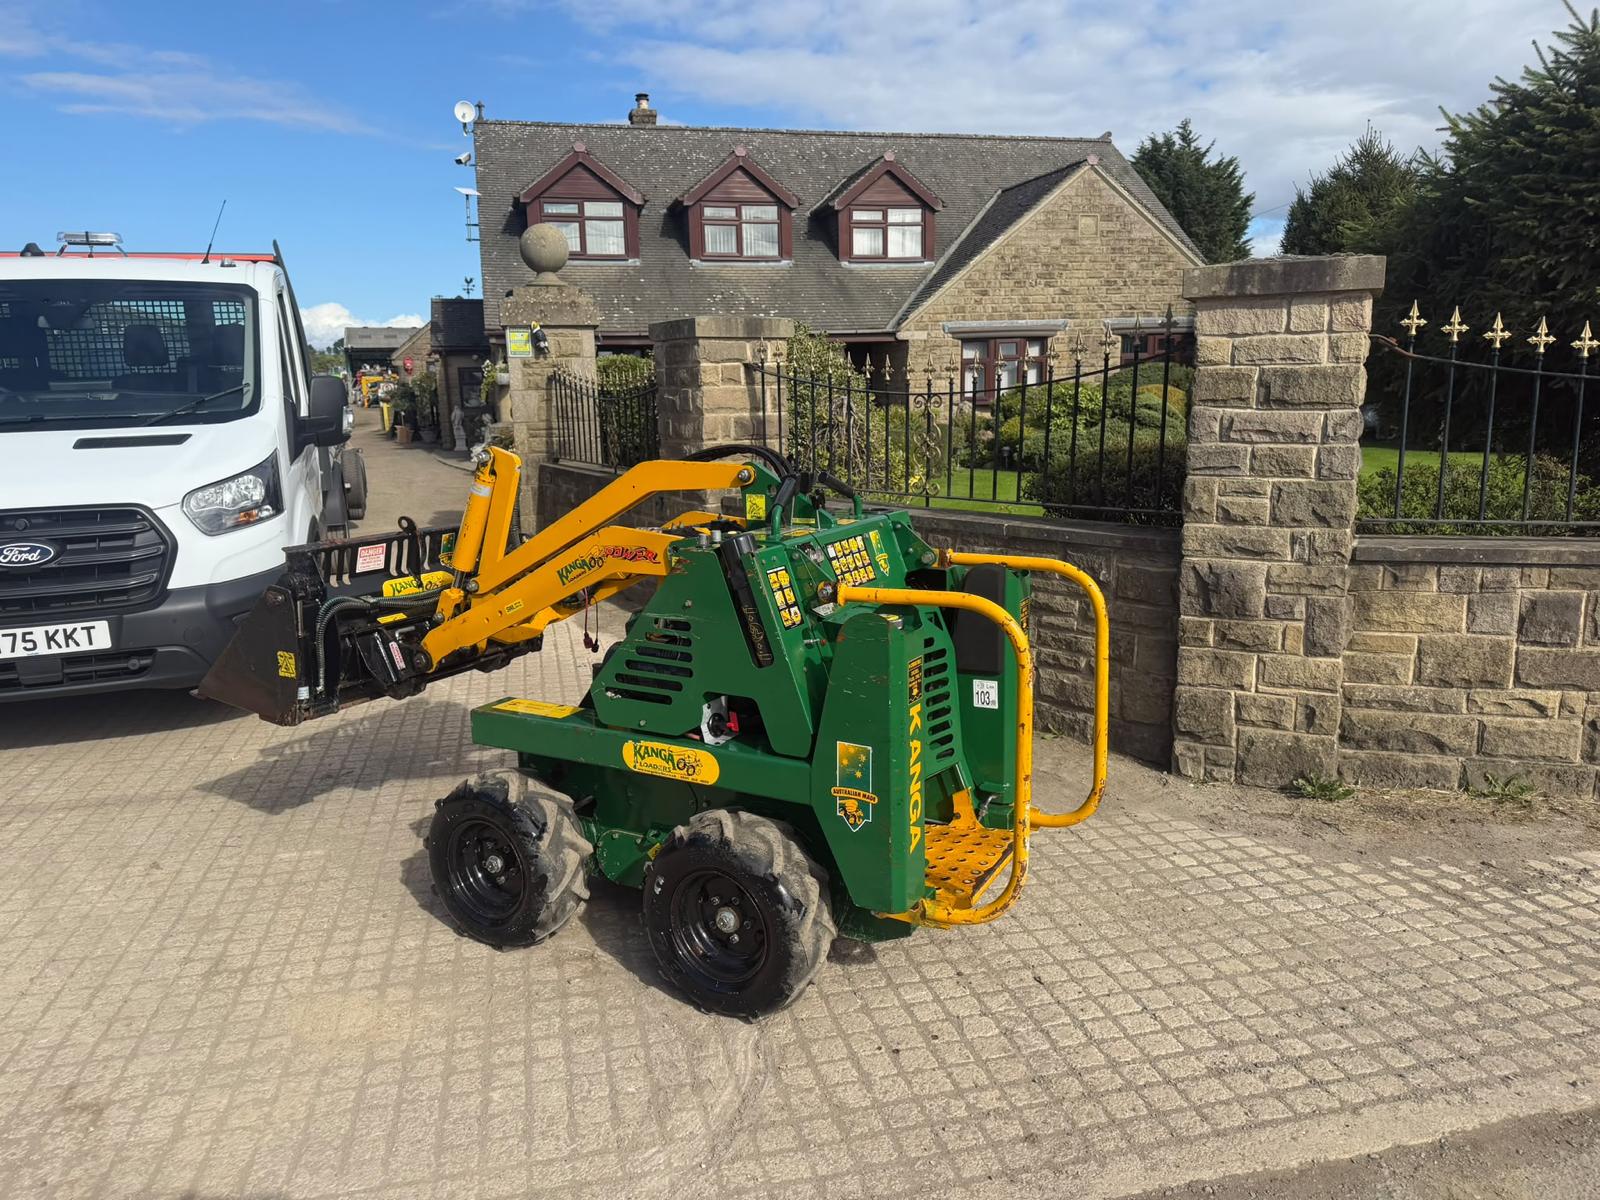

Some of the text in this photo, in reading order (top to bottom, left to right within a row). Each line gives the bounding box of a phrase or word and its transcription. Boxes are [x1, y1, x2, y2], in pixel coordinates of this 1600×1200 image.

[0, 546, 41, 563] Ford
[360, 545, 383, 557] DANGER
[557, 558, 591, 586] KANGA
[0, 625, 96, 655] 75 KKT
[975, 690, 991, 706] 103
[633, 743, 677, 771] KANGA
[909, 702, 921, 855] KANGA
